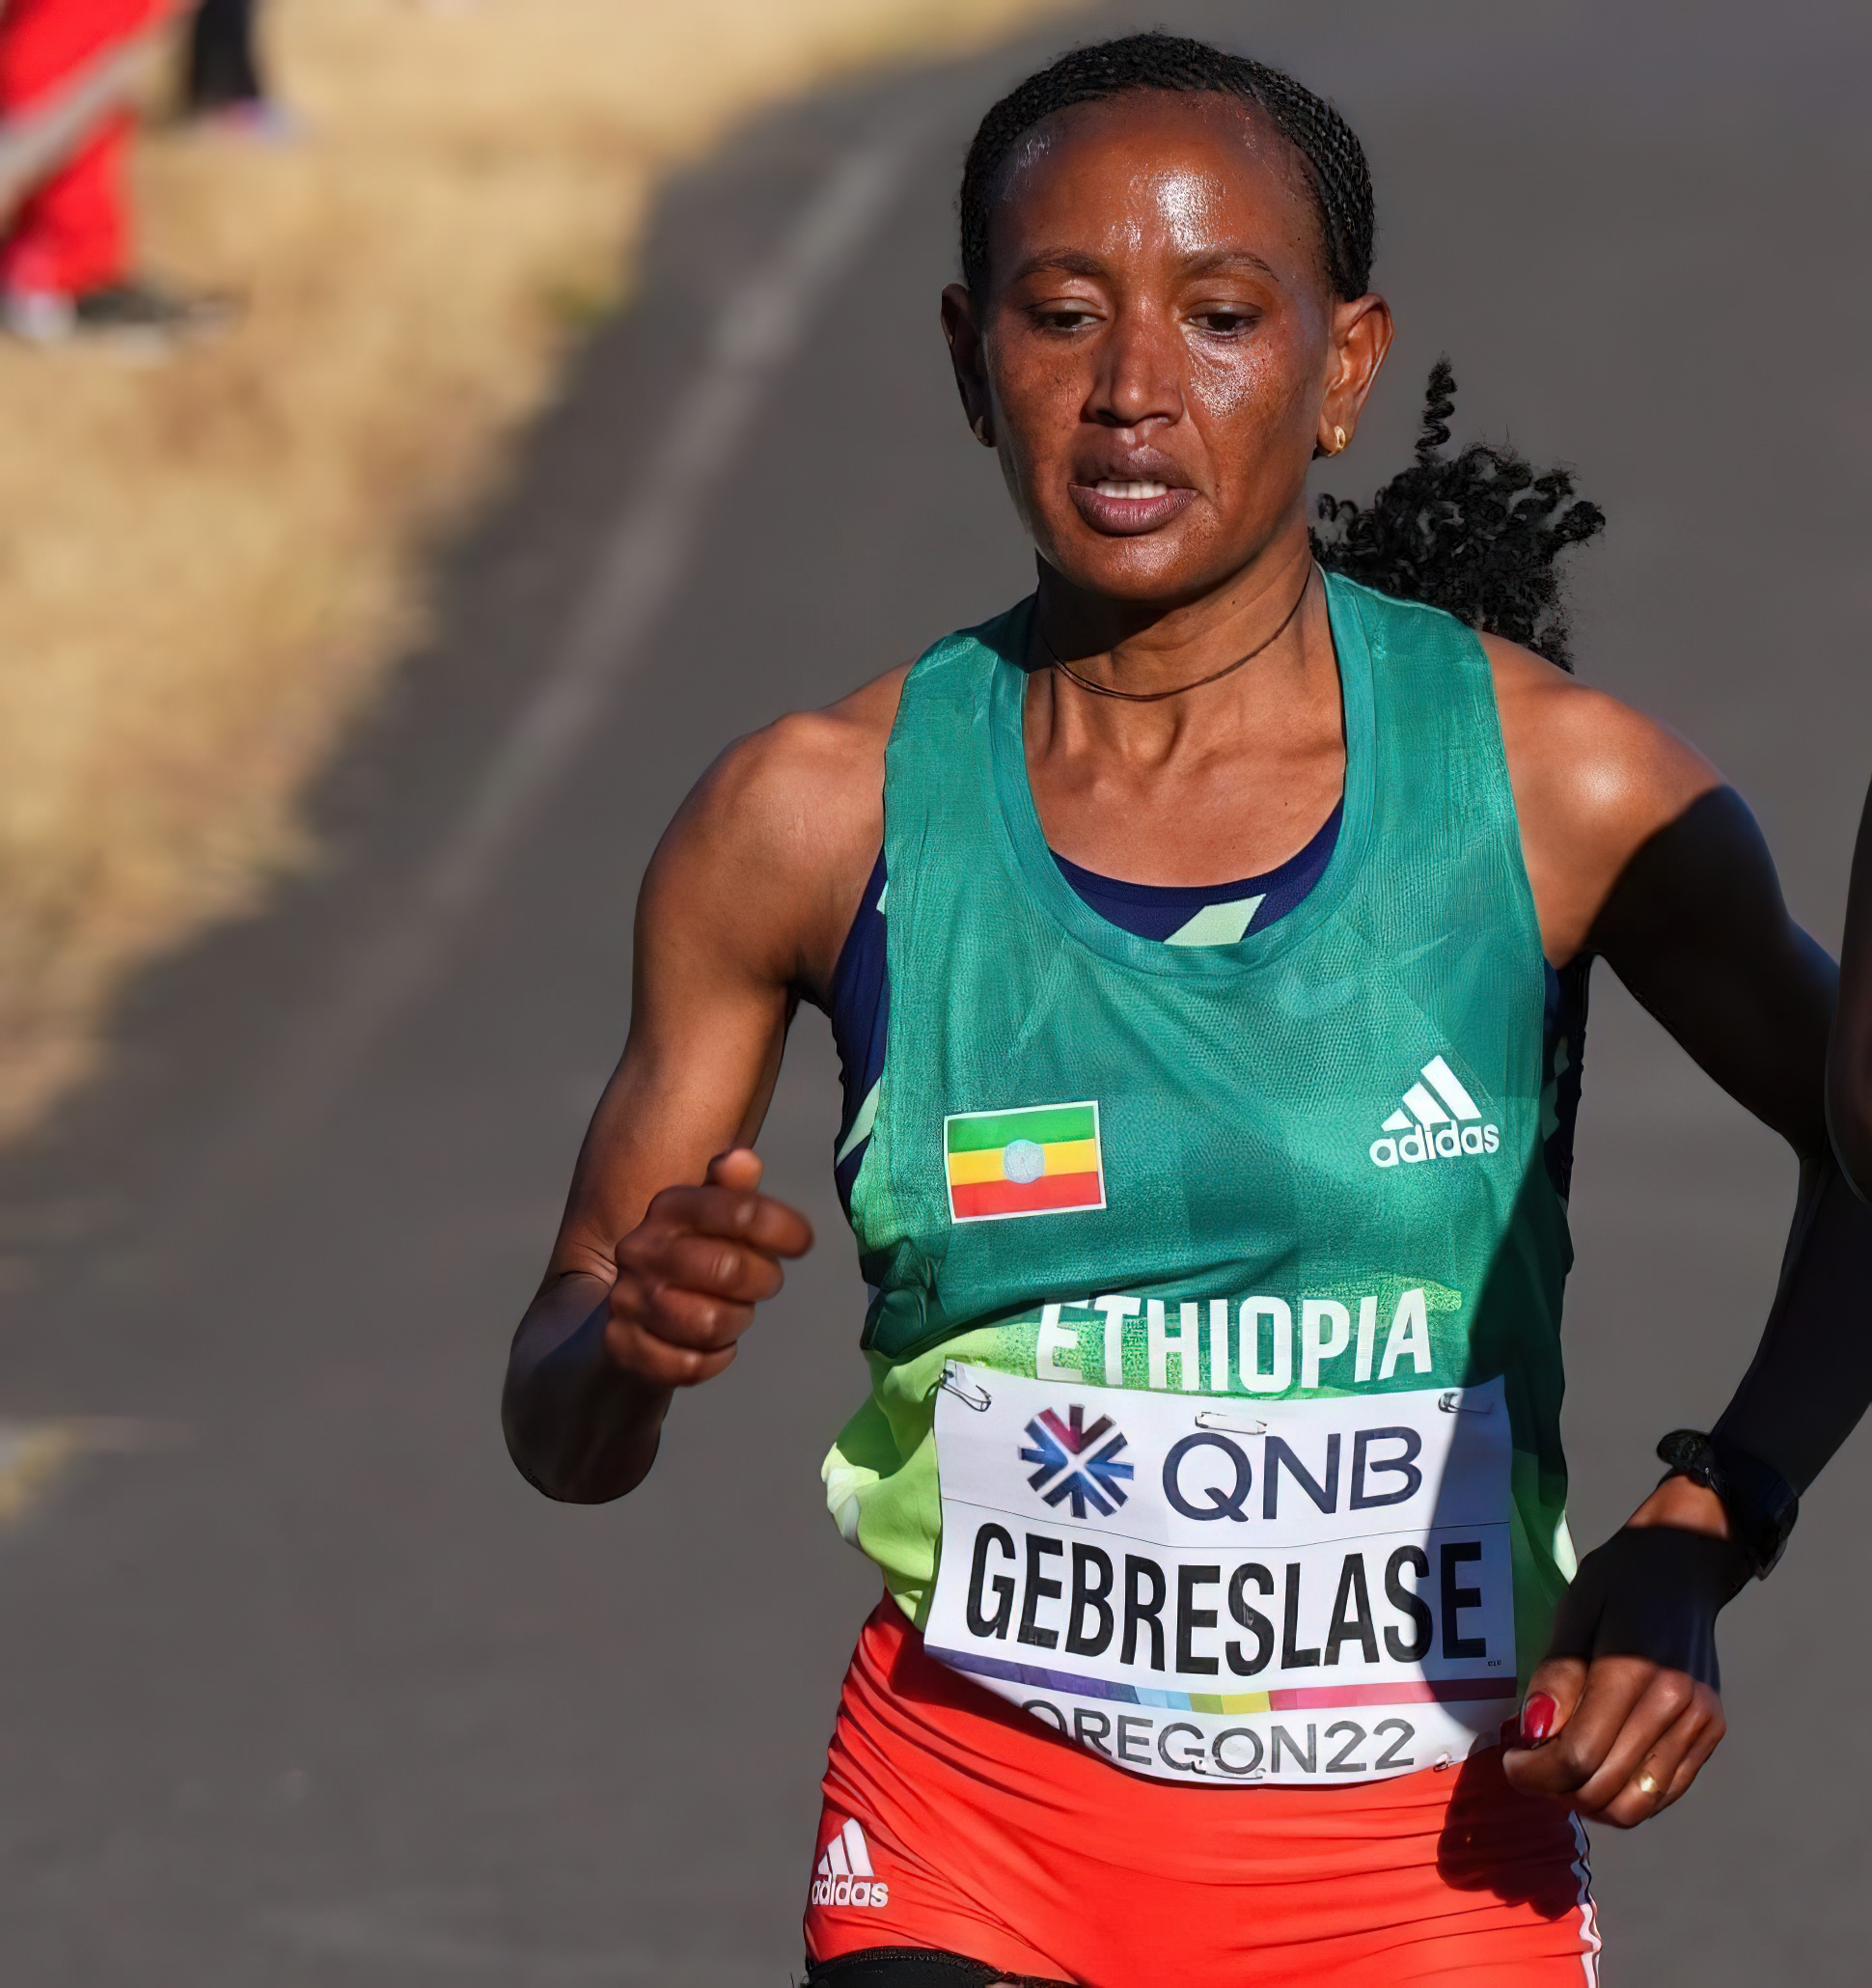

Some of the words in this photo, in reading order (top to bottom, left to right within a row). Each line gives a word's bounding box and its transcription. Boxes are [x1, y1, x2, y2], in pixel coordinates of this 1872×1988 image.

[1369, 1119, 1500, 1168] adidas
[1036, 1287, 1433, 1393] ETHIOPIA
[1162, 1426, 1422, 1522] QNB
[966, 1522, 1487, 1676] GEBRESLASE
[812, 1873, 889, 1908] adidas
